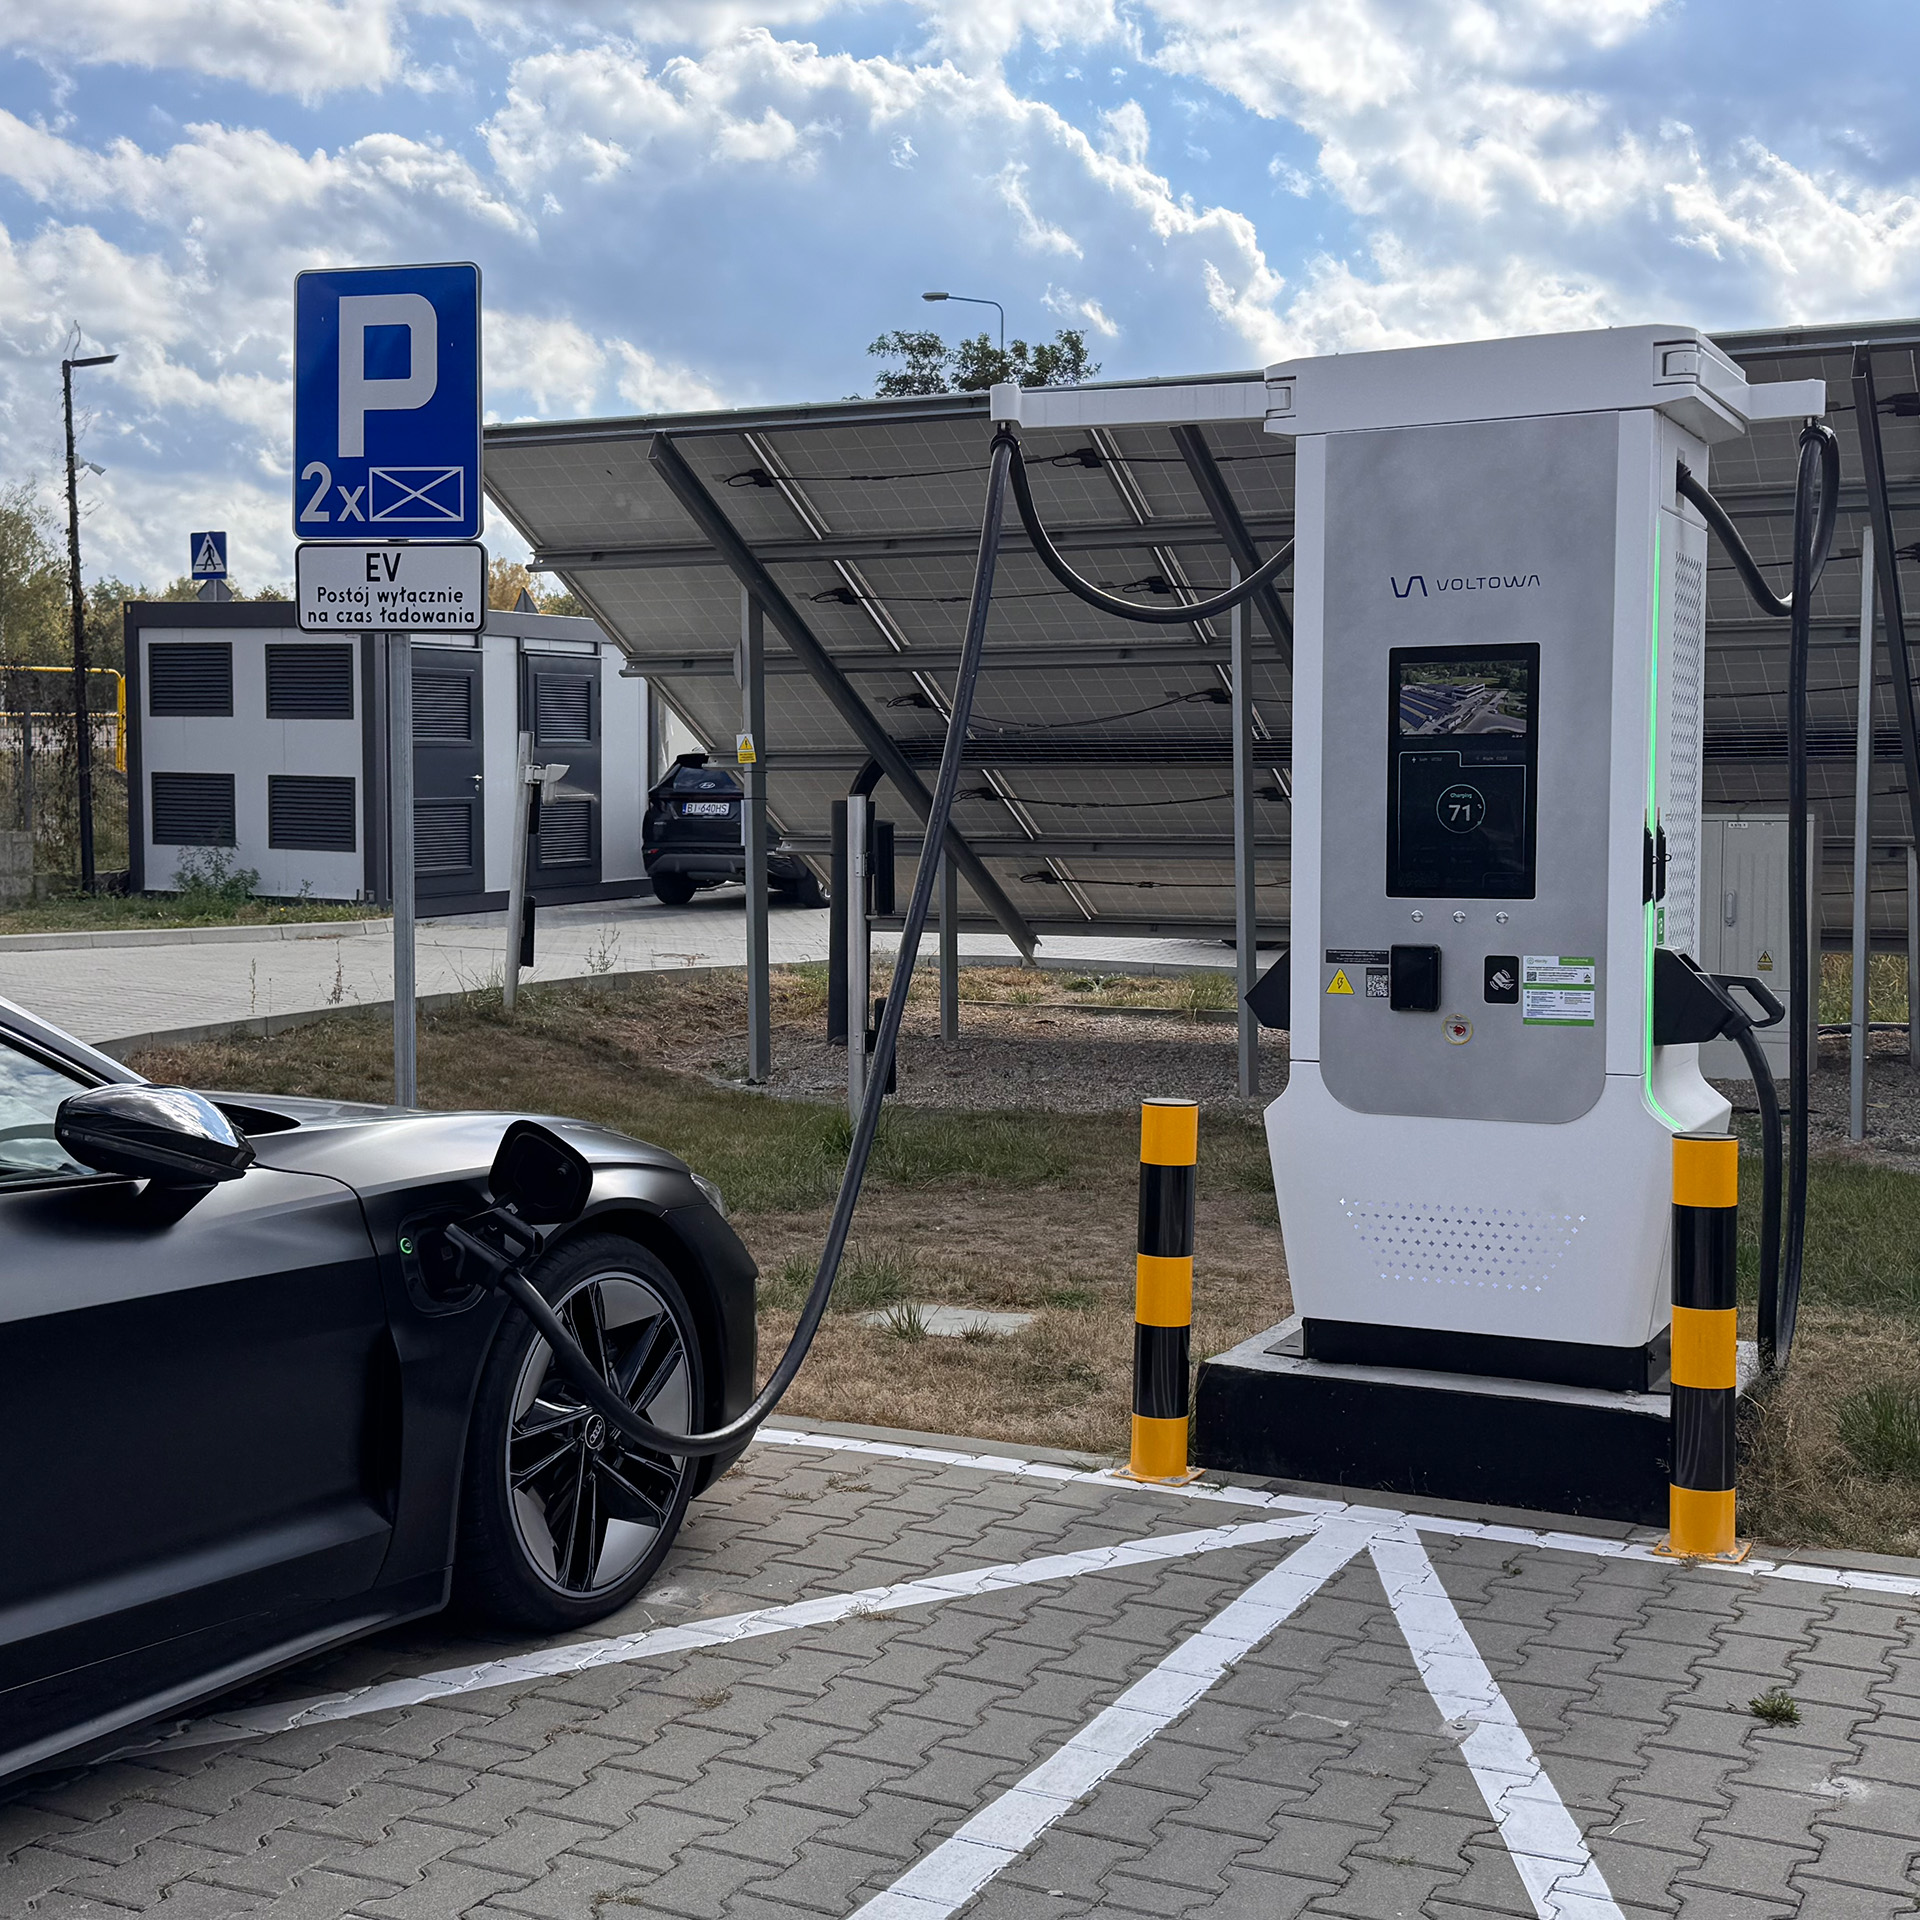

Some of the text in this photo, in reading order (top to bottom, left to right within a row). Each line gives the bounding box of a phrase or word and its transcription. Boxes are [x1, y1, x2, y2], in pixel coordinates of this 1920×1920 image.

[338, 293, 438, 458] P
[300, 461, 366, 522] 2x
[366, 553, 401, 582] EV
[1436, 574, 1541, 591] VOLTOWA
[318, 586, 464, 608] Postój wyłącznie
[308, 607, 475, 623] na czas ładowania
[1449, 804, 1471, 822] 71
